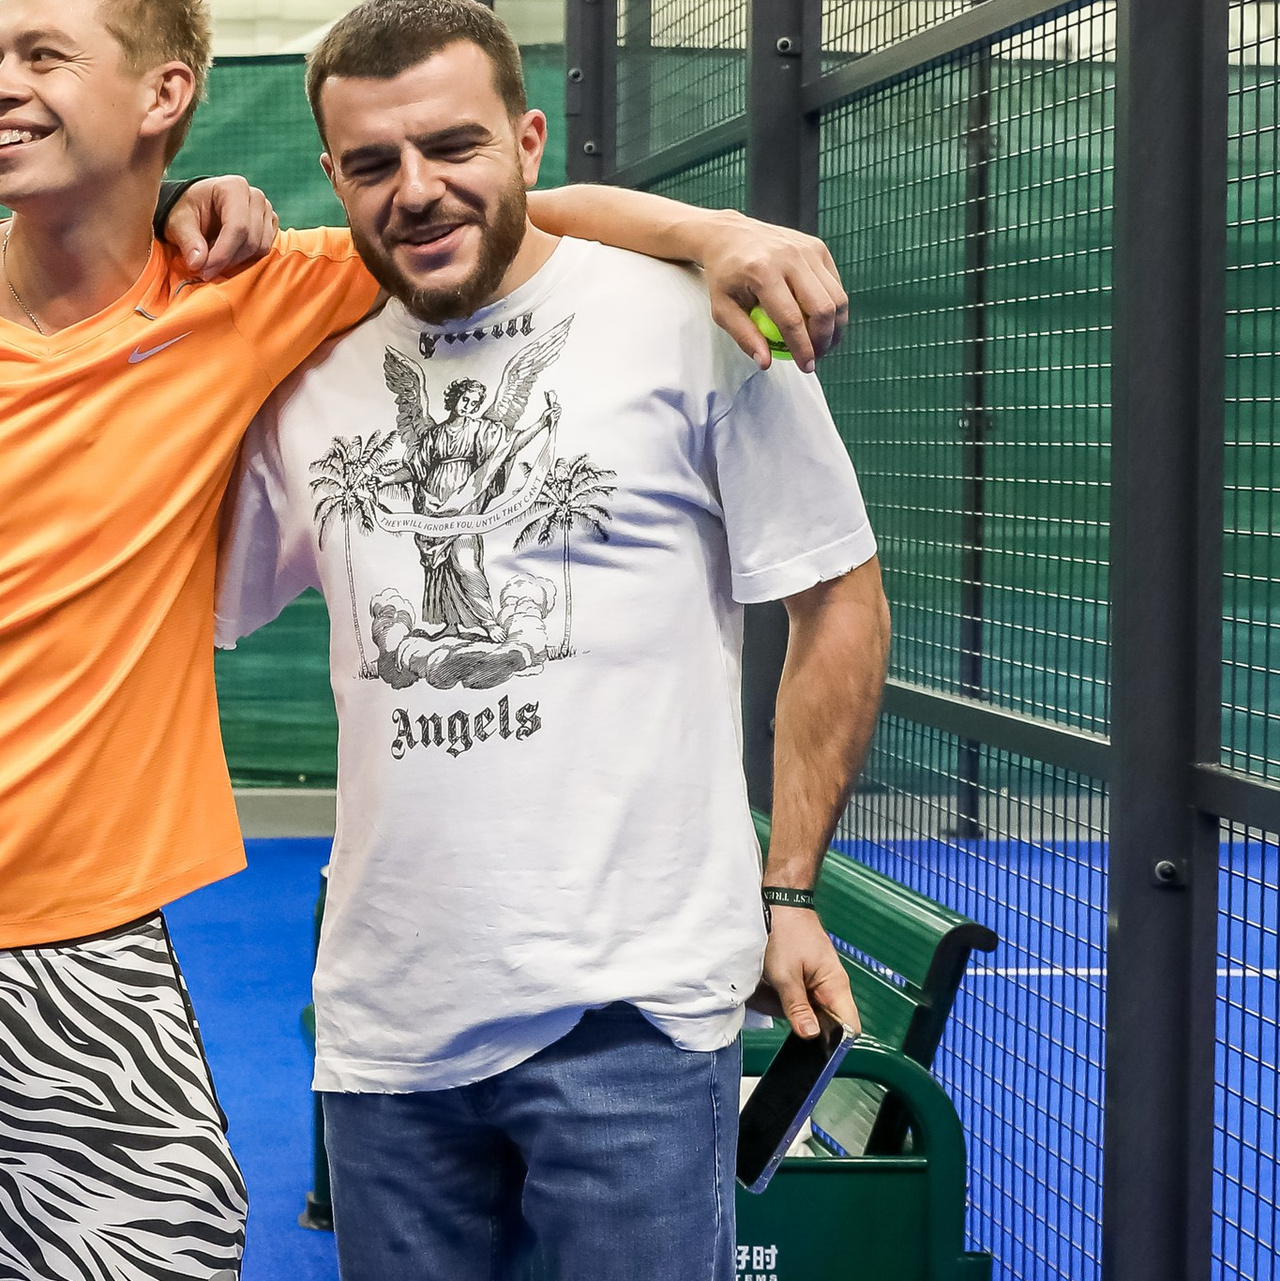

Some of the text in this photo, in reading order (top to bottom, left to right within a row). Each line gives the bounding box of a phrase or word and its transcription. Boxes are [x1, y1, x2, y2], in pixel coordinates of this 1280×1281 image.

[381, 517, 401, 528] THEY
[402, 519, 422, 528] WILL
[423, 521, 455, 532] IGNORE
[476, 513, 501, 528] UNTIL
[502, 502, 523, 517] THEY
[391, 694, 542, 760] Angels
